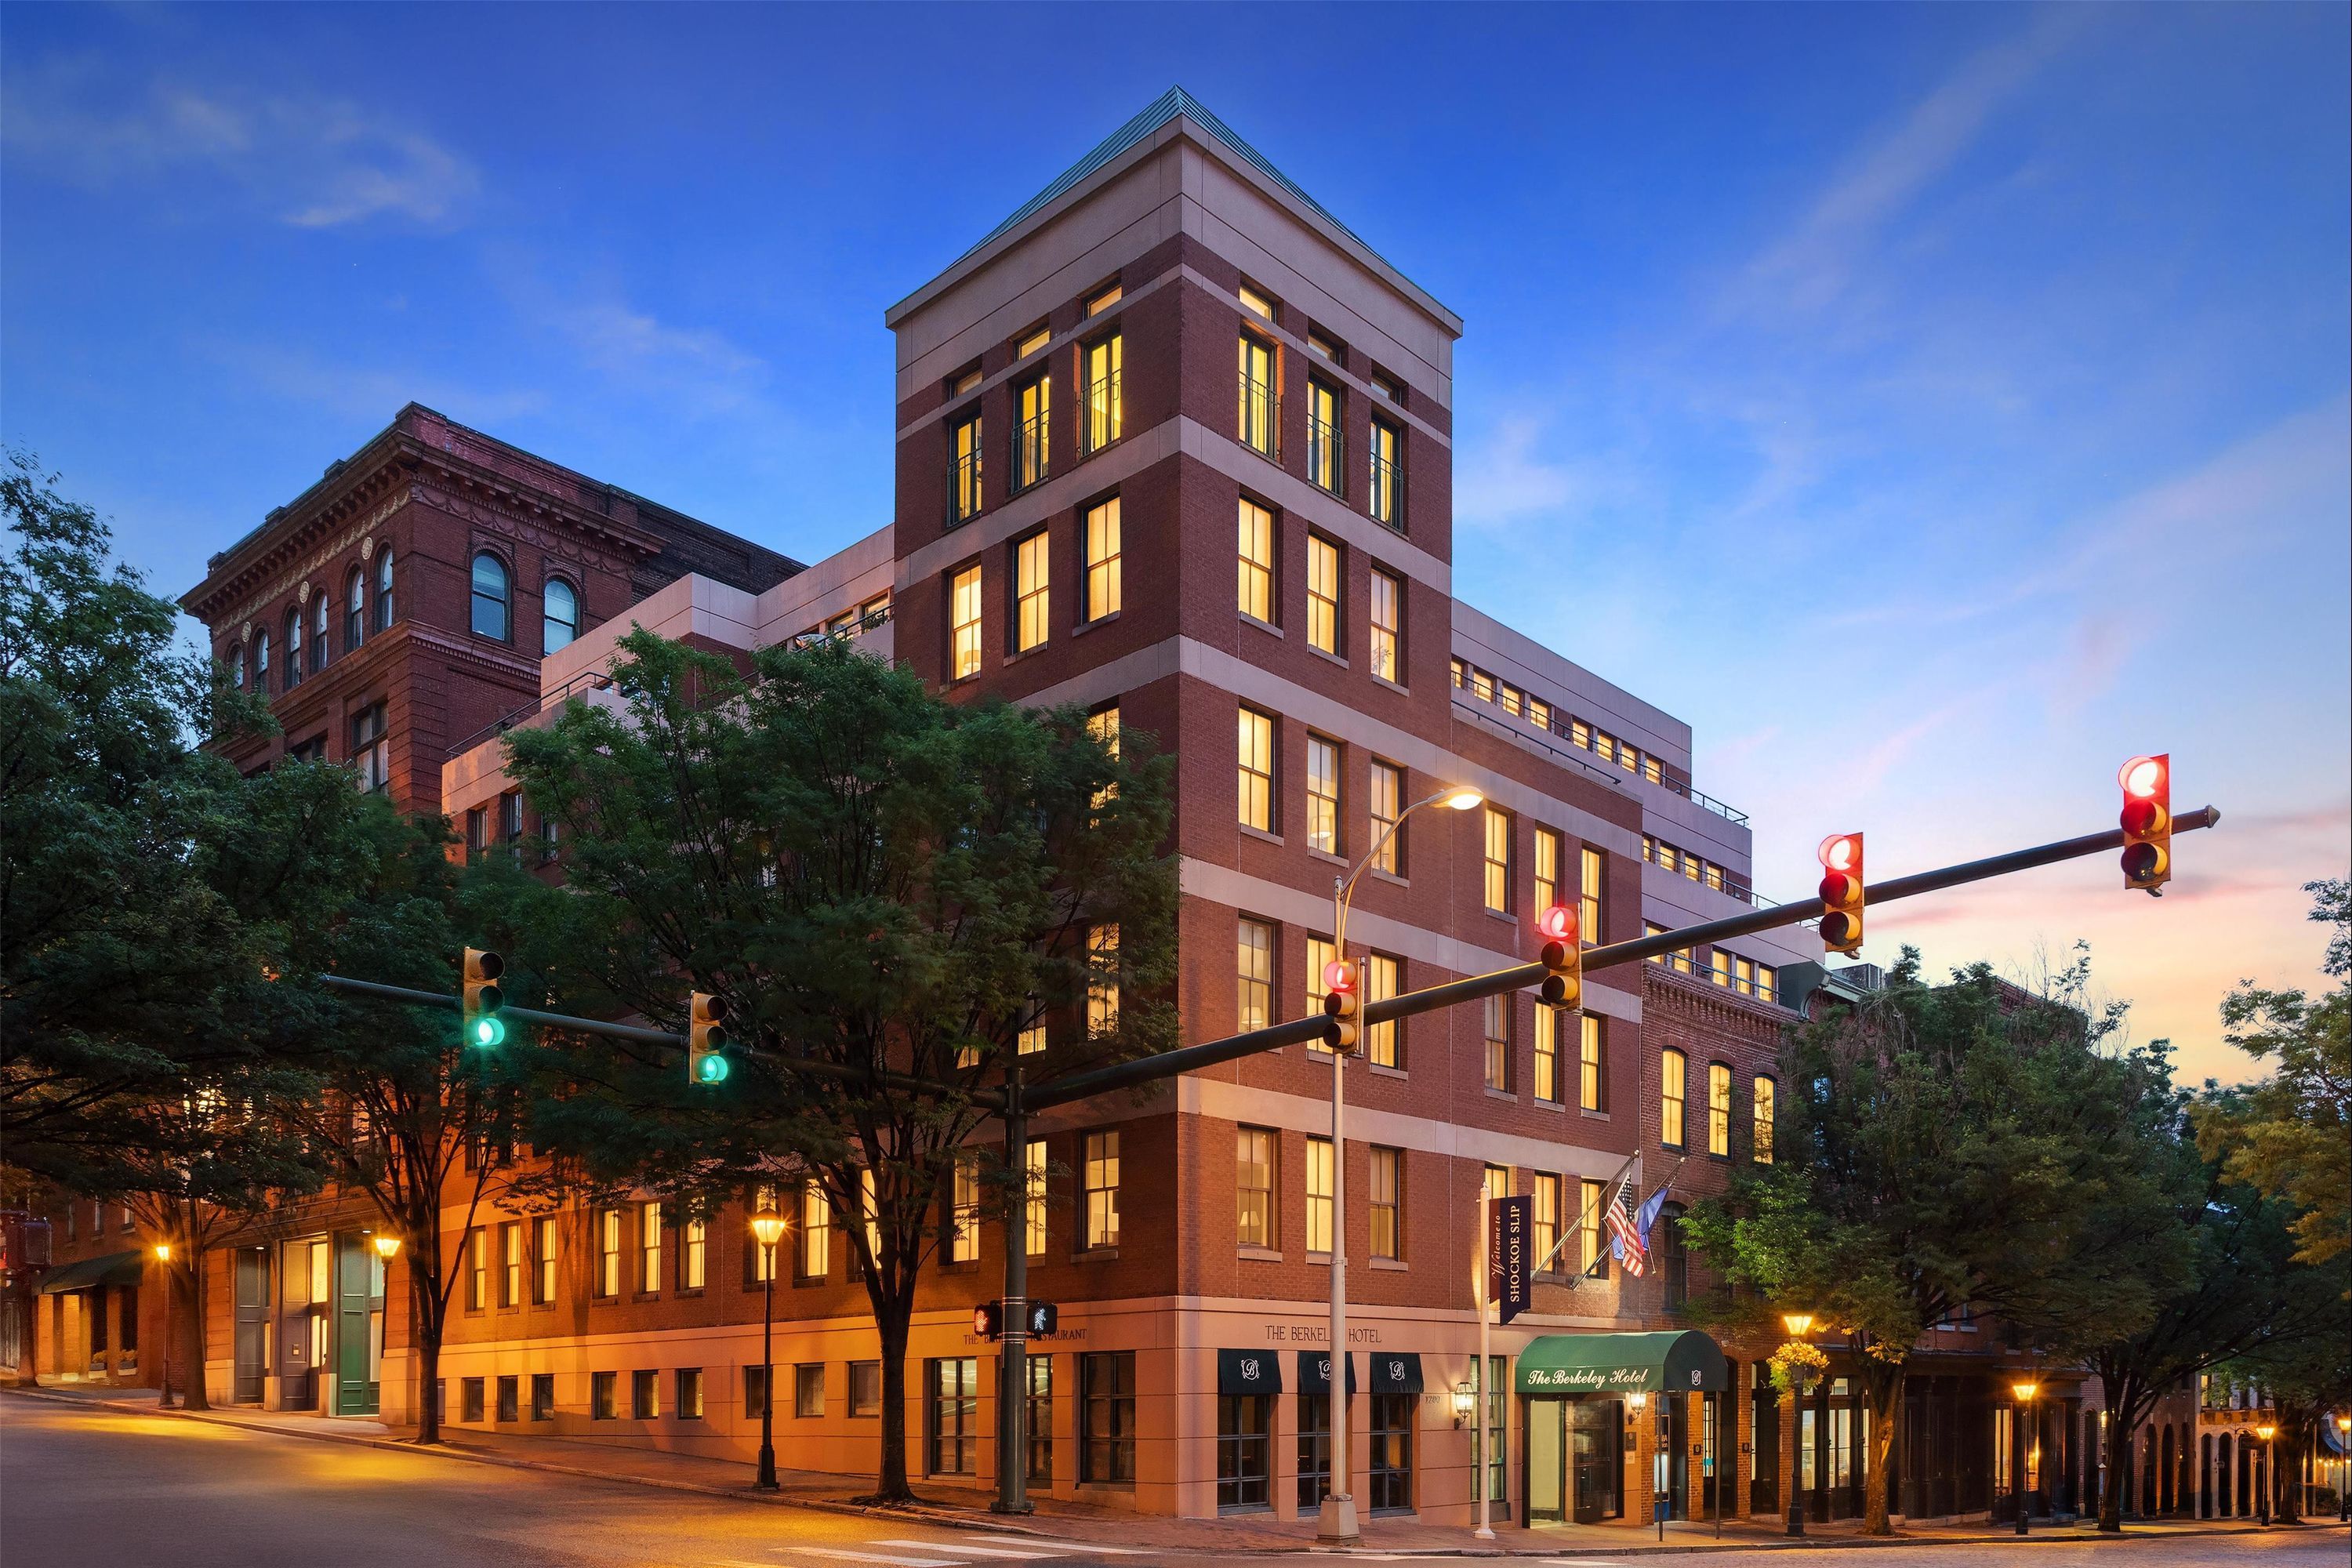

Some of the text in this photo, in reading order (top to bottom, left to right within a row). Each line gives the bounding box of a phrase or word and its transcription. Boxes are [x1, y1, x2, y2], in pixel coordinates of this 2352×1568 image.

[1491, 1215, 1505, 1279] Welcome to
[1510, 1205, 1520, 1302] SHOCKOE SLIP
[964, 1334, 978, 1345] THE
[1030, 1329, 1087, 1341] STAURANT
[1265, 1325, 1382, 1343] THE BERKEL HOTEL
[1527, 1368, 1649, 1389] The Berkeley Hotel
